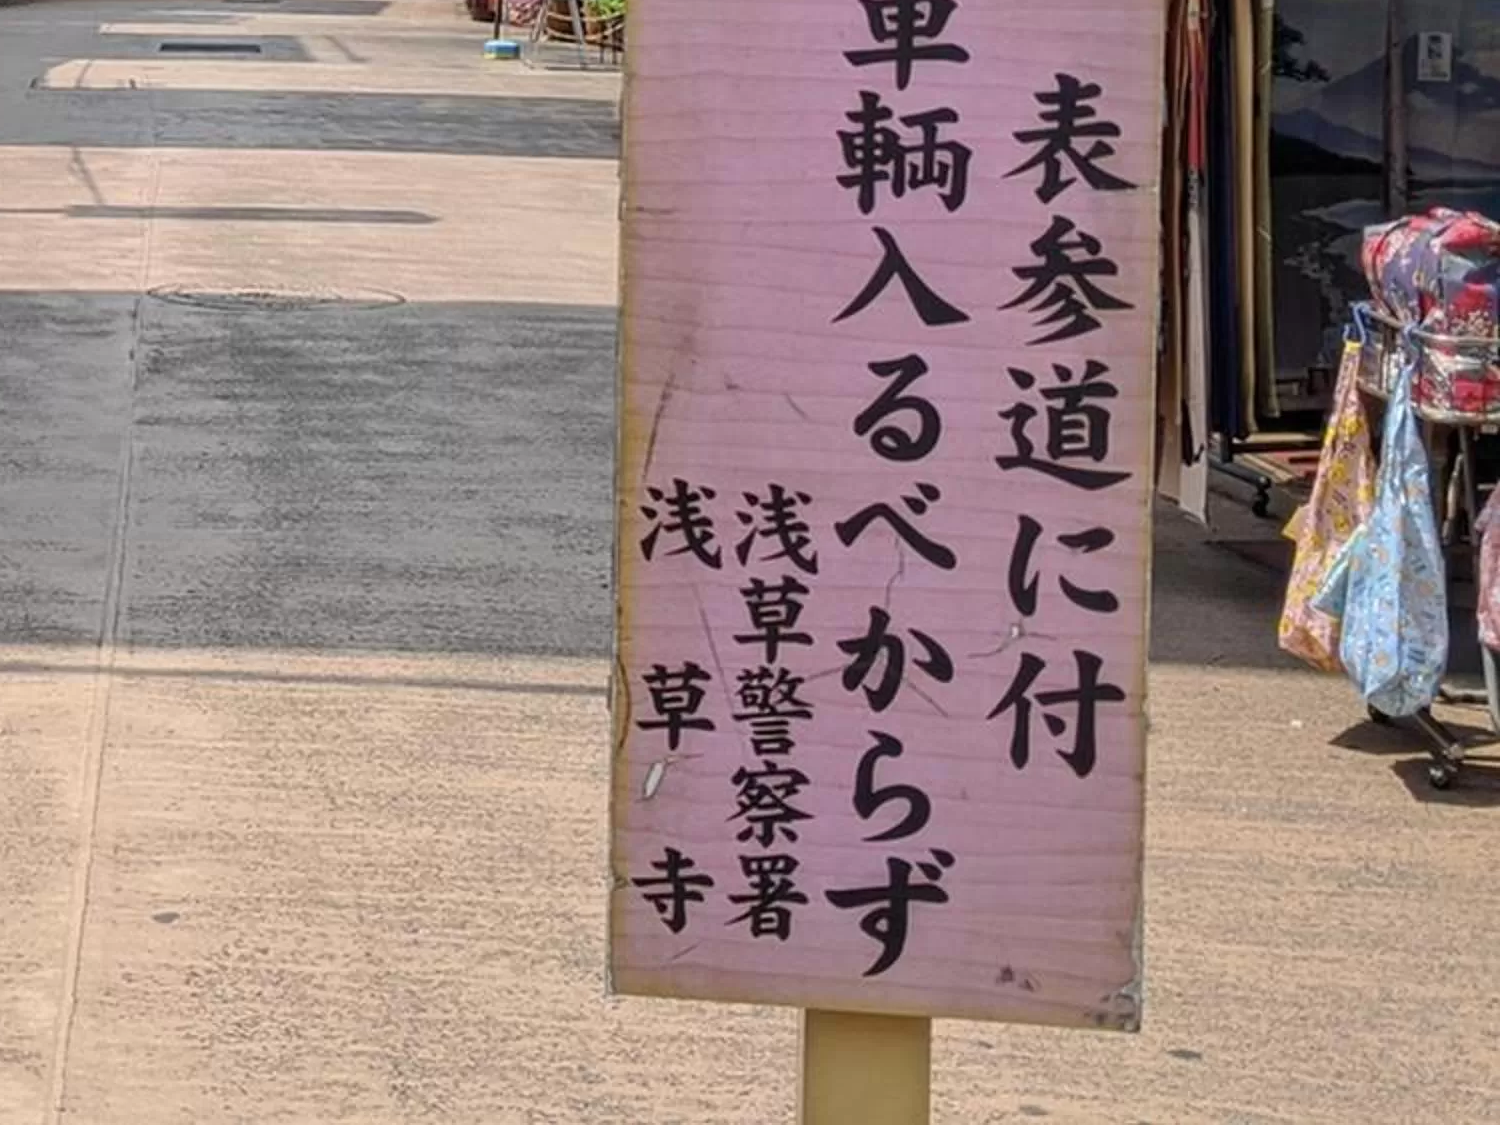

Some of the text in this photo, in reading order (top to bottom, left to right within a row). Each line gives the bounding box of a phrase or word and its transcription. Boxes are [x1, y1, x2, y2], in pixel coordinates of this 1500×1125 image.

[988, 73, 1138, 778] 表参道に付
[631, 478, 722, 934] 浅草寺
[725, 485, 818, 941] 浅草警察署
